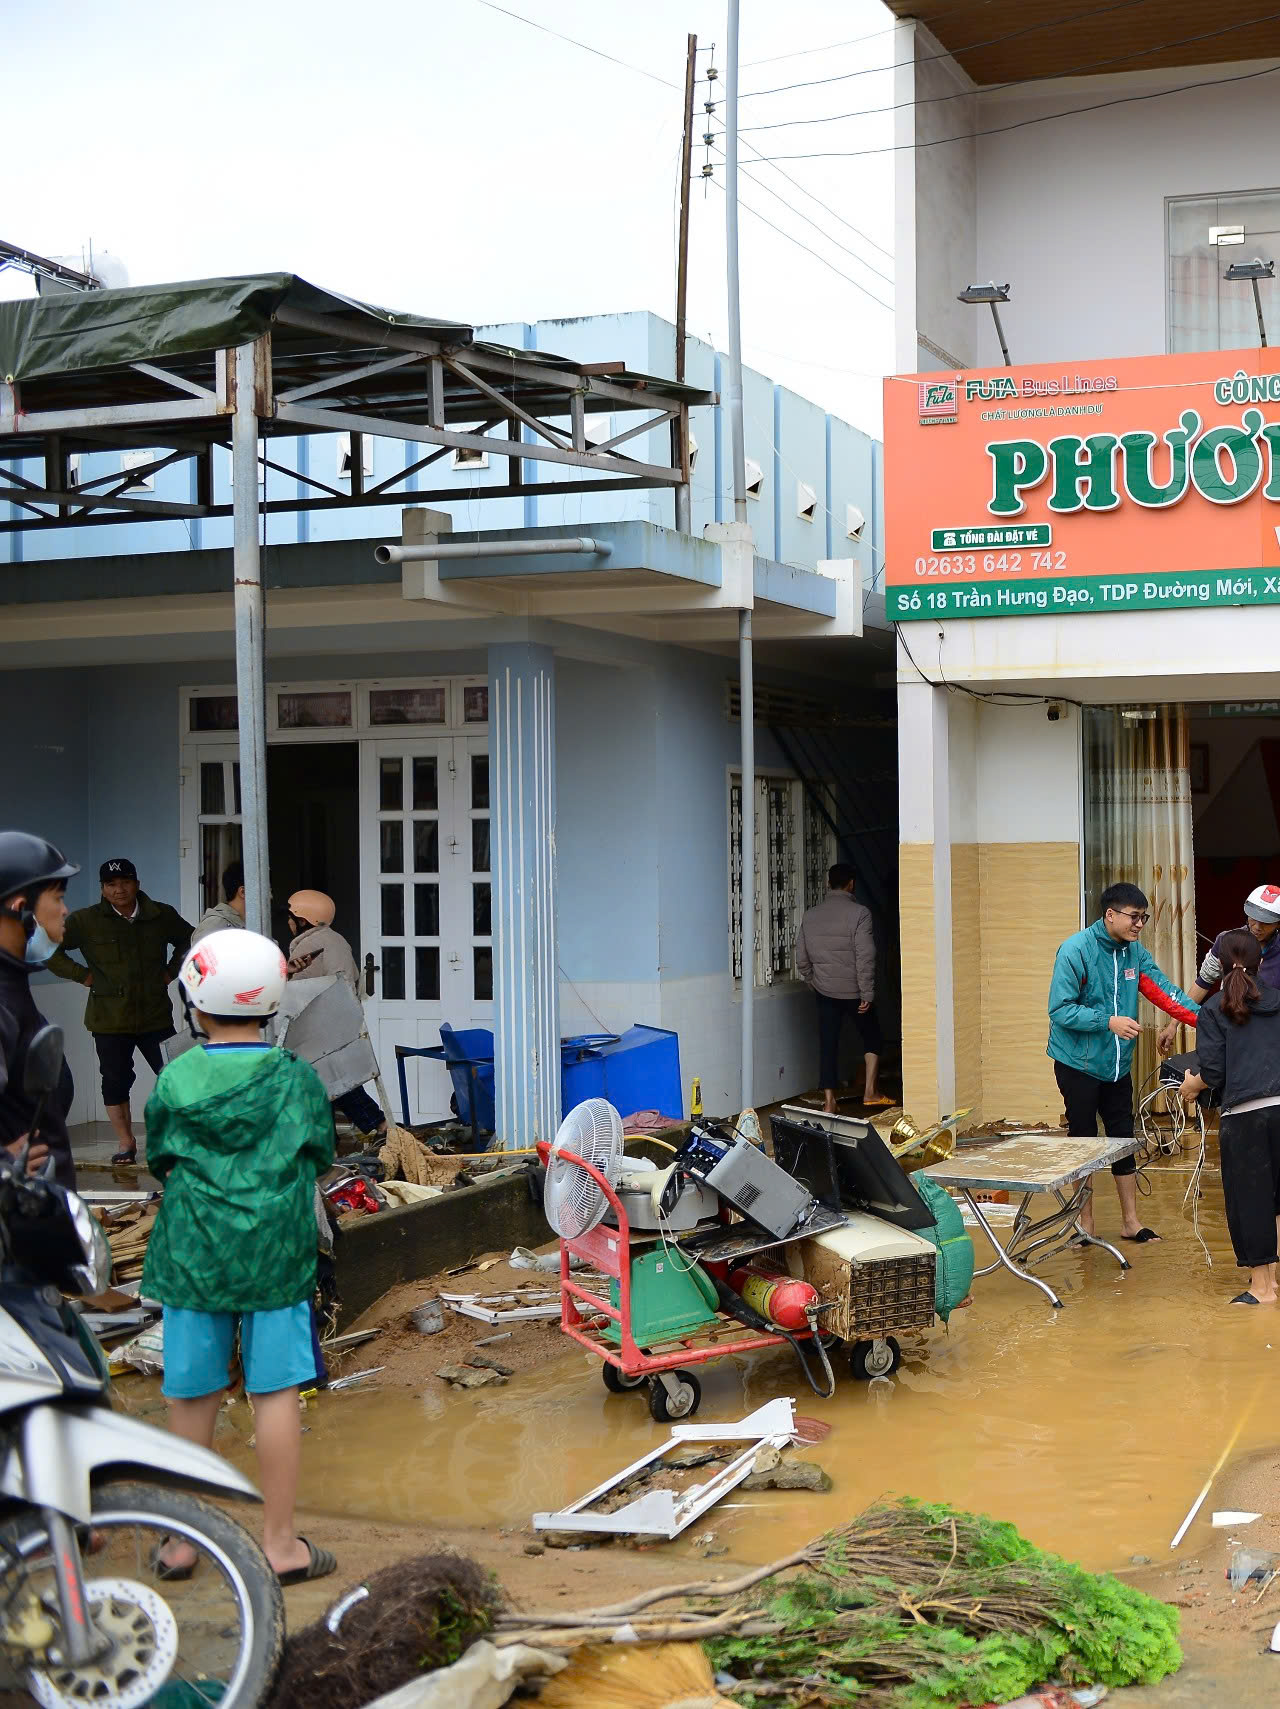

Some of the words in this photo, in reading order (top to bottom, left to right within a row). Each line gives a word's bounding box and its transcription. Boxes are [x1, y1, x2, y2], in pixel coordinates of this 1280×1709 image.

[966, 378, 1018, 401] FUTA
[1021, 379, 1059, 398] Bus
[1062, 375, 1118, 395] Lines
[960, 529, 985, 545] TỔNG
[987, 531, 1003, 544] ĐÀI
[1005, 530, 1024, 544] ĐẶT
[1026, 529, 1038, 541] VÉ
[915, 555, 977, 576] 02633
[983, 553, 1022, 573] 642
[1030, 551, 1067, 571] 742
[897, 589, 922, 611] Số
[927, 592, 947, 609] 18
[952, 587, 992, 608] Trần
[998, 589, 1048, 608] Hưng
[1052, 586, 1095, 607] Đạo,
[1099, 583, 1138, 601] TDP
[1143, 581, 1210, 601] Đường
[1216, 578, 1257, 598] Mới,
